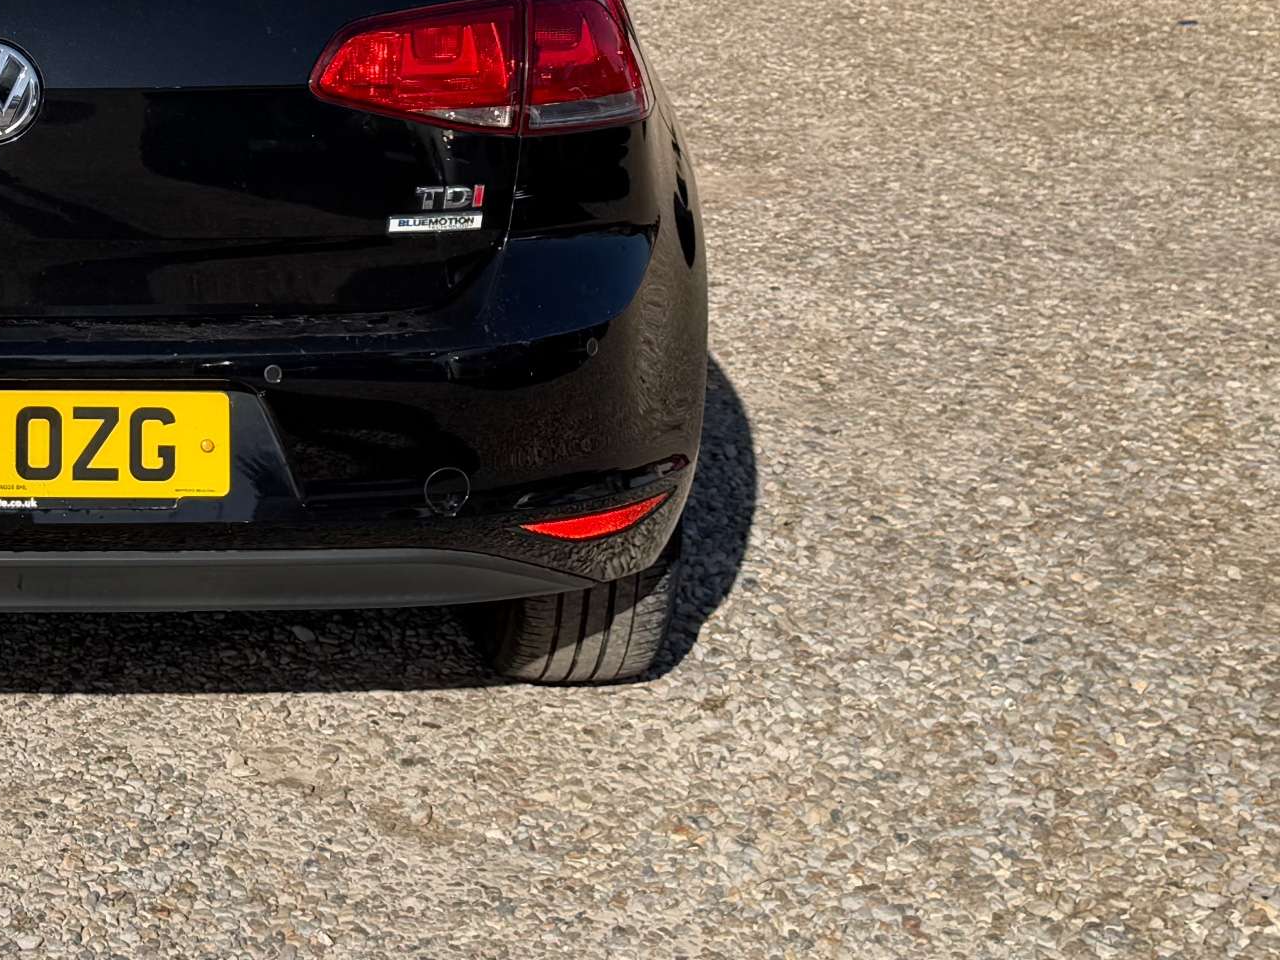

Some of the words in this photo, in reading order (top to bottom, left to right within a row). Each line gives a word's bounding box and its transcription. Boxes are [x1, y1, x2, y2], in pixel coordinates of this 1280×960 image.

[415, 183, 486, 211] TDI
[398, 216, 475, 228] BLUEMOTION
[14, 404, 177, 482] OZG
